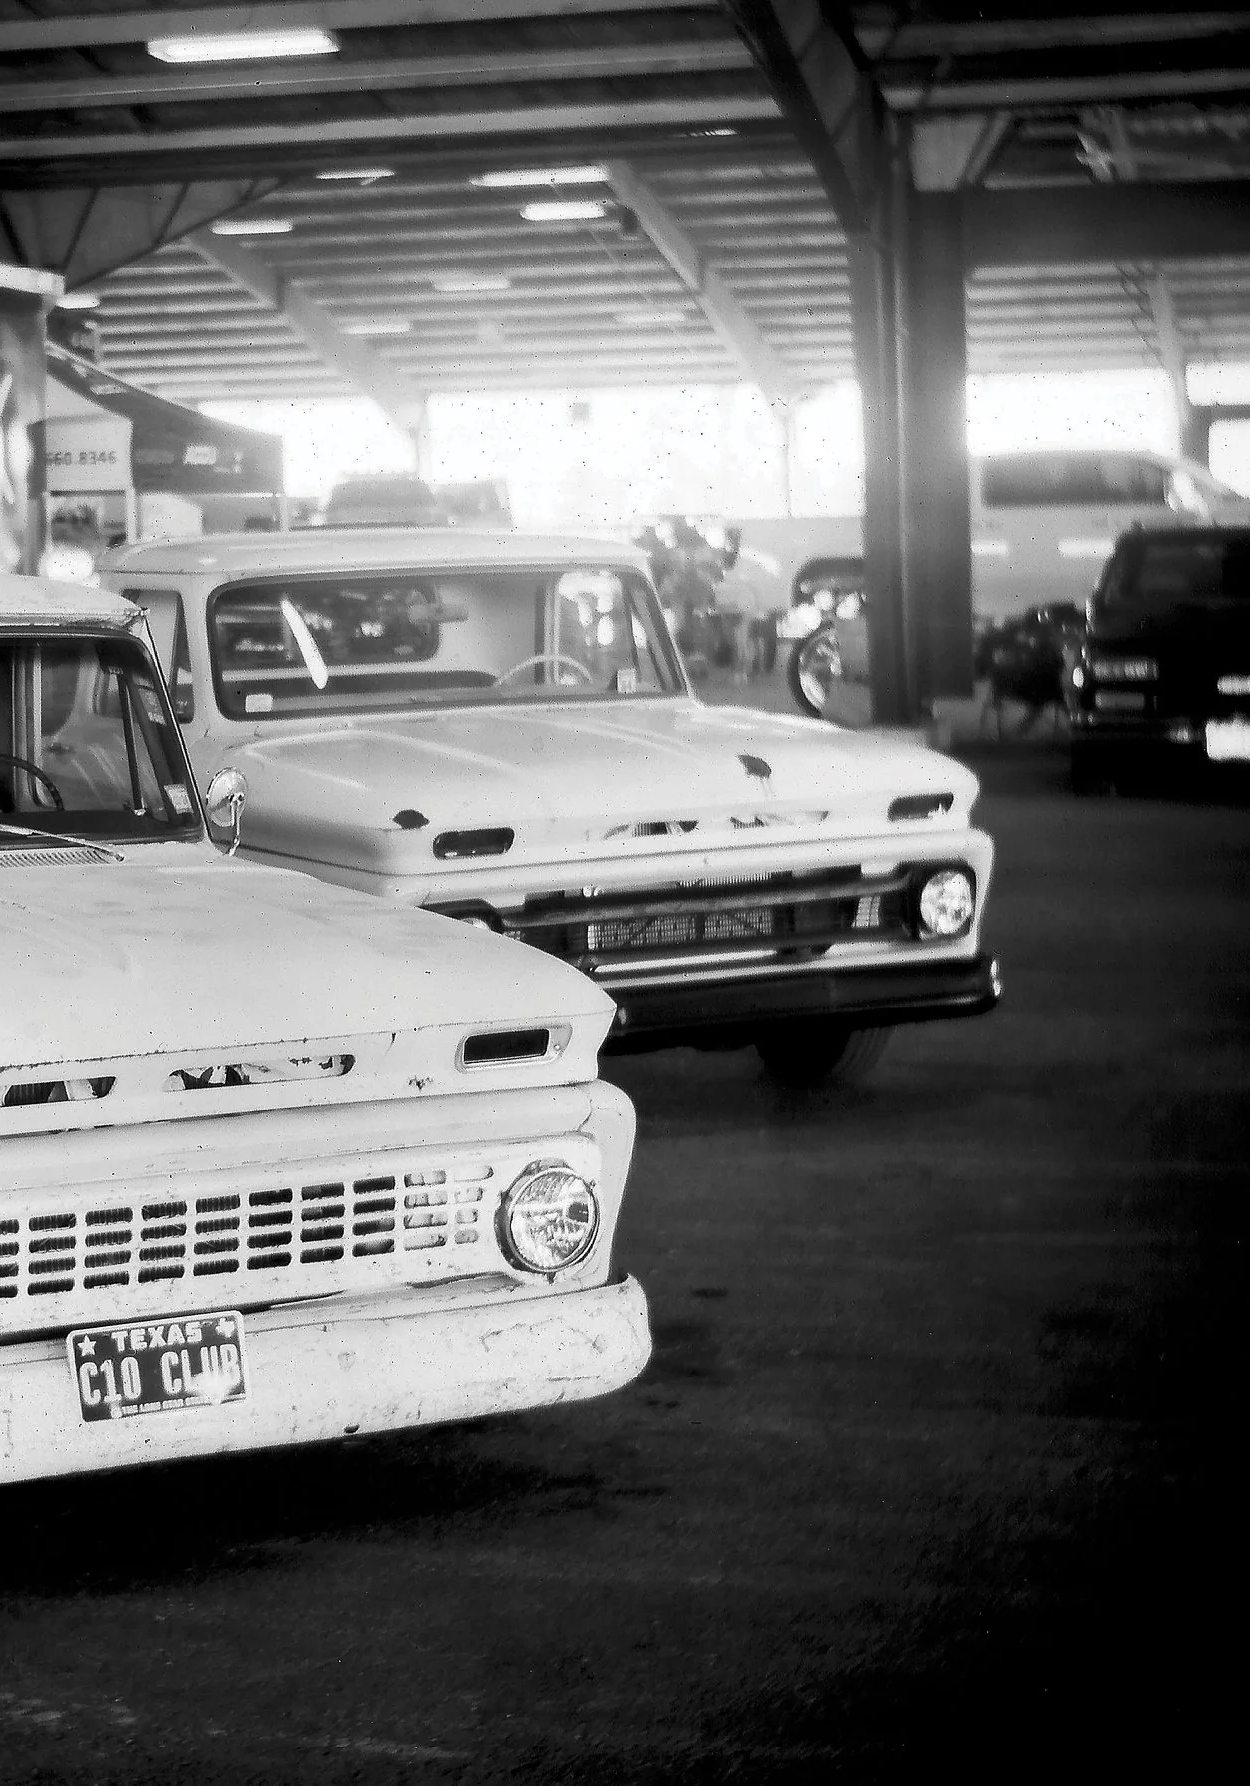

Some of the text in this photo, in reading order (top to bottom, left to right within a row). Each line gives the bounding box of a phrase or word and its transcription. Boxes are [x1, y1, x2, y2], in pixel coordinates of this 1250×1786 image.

[111, 1321, 202, 1352] TEXAS
[79, 1343, 242, 1405] C10 CLUB
